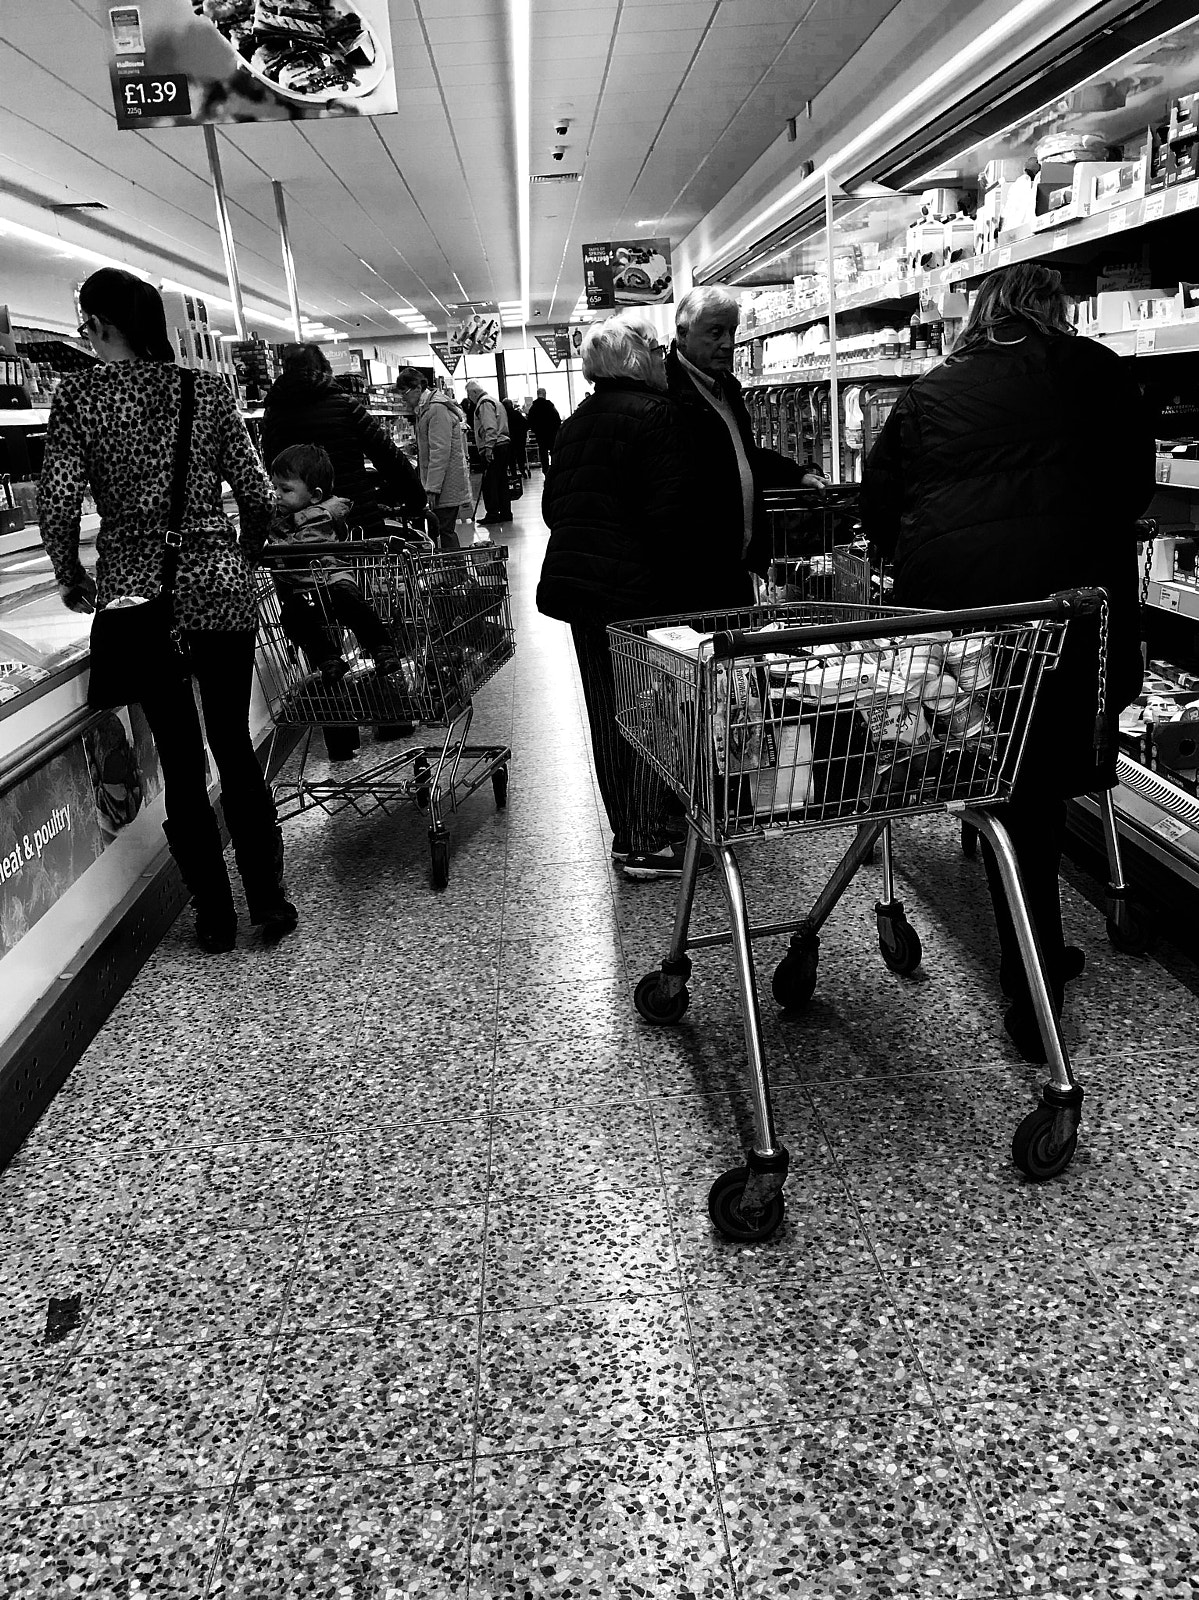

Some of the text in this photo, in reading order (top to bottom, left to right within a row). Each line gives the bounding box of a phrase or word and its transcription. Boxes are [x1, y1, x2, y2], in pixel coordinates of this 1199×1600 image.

[124, 81, 177, 105] £1.39
[126, 107, 142, 116] 225g
[589, 295, 602, 303] 65p
[871, 717, 895, 732] cashew
[23, 834, 35, 860] &
[33, 803, 71, 859] poultry
